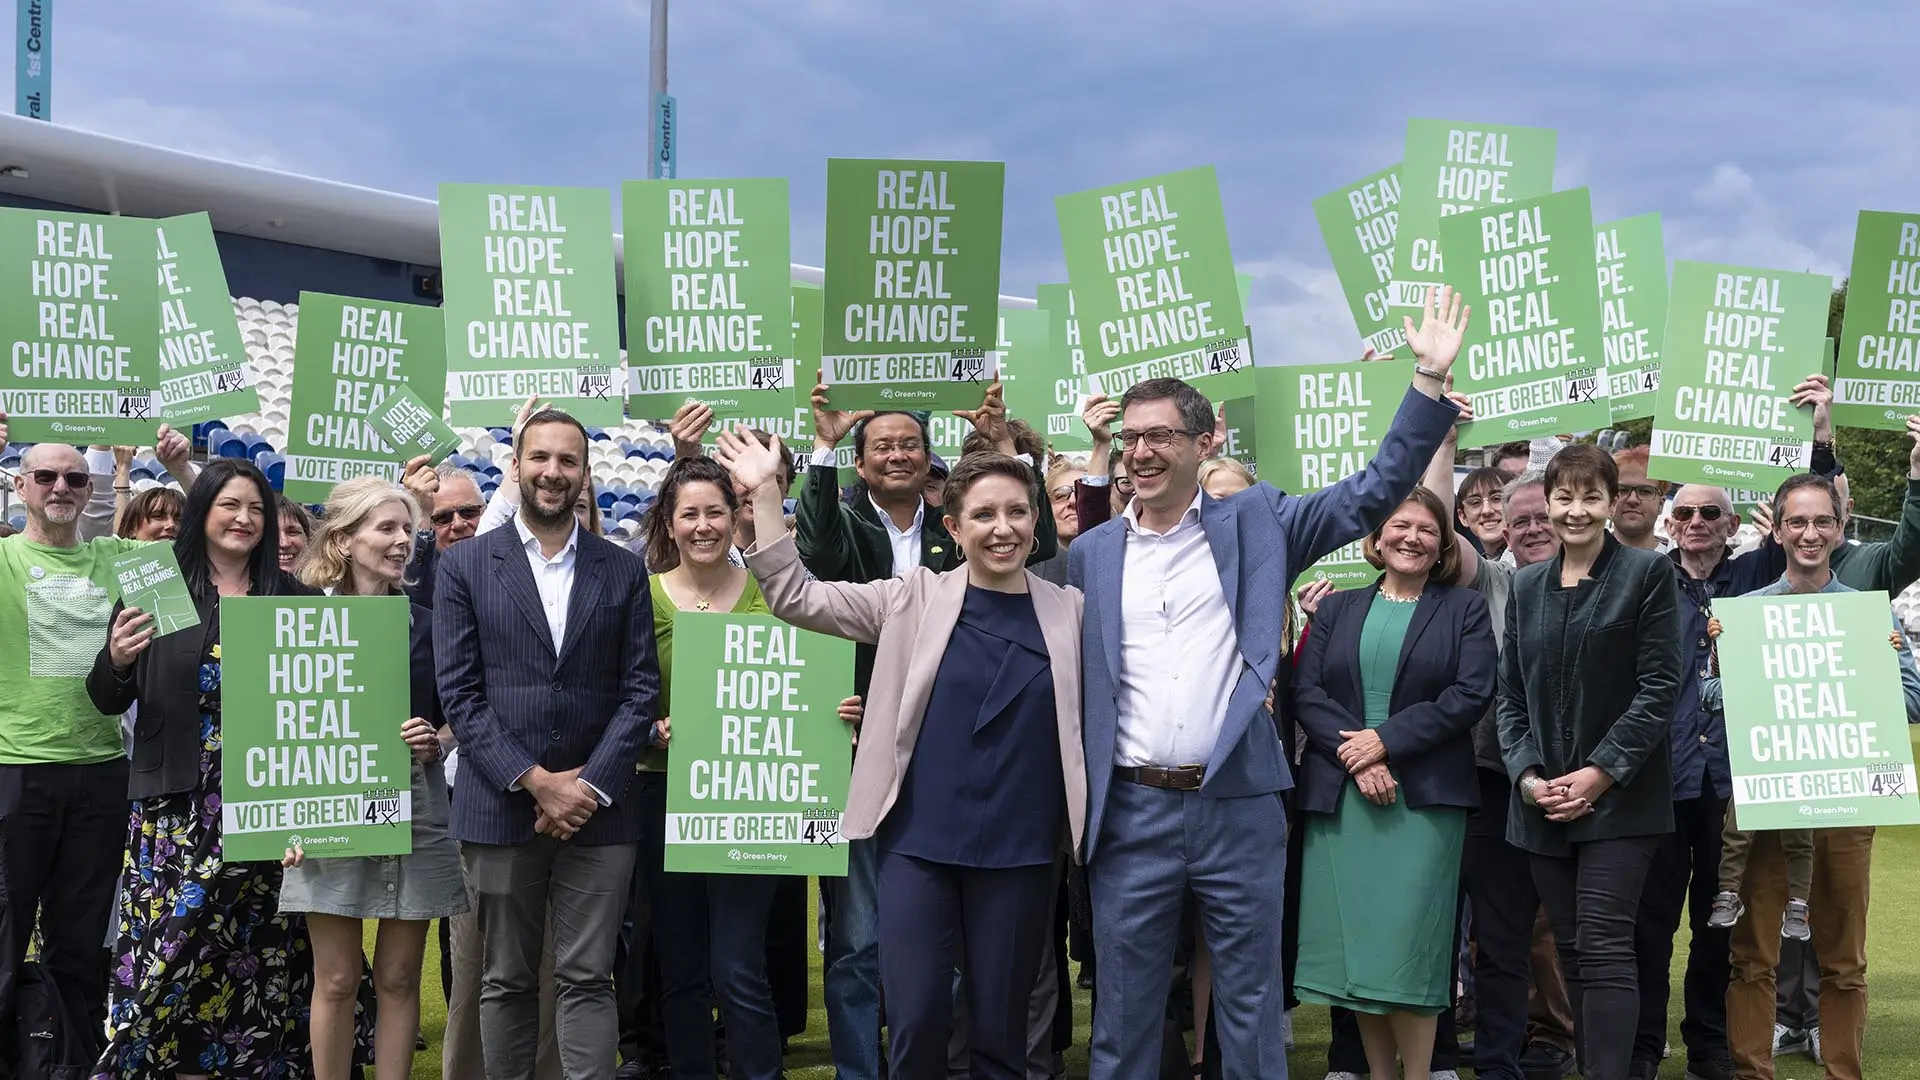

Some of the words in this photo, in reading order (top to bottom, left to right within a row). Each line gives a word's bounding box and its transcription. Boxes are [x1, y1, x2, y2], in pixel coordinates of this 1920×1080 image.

[1446, 130, 1513, 166] REAL
[877, 170, 955, 210] REAL
[1437, 166, 1514, 204] HOPE.
[488, 194, 566, 232] REAL
[668, 188, 744, 226] REAL
[1101, 185, 1178, 232] REAL
[37, 220, 112, 260] REAL
[869, 216, 958, 255] HOPE.
[1354, 210, 1399, 254] HOP
[1481, 206, 1551, 253] REAL
[1596, 229, 1627, 263] AL
[484, 236, 574, 274] HOPE.
[664, 231, 748, 268] HOPE.
[1103, 224, 1190, 273] HOPE.
[32, 260, 118, 300] HOPE.
[874, 260, 951, 299] REAL
[1117, 266, 1192, 312] REAL
[1480, 247, 1559, 296] HOPE.
[1598, 262, 1634, 298] PE.
[494, 279, 572, 316] REAL
[671, 274, 746, 310] REAL
[1714, 272, 1784, 314] REAL
[39, 301, 114, 341] REAL
[160, 298, 197, 334] AL
[340, 306, 408, 344] REAL
[844, 304, 975, 342] CHANGE.
[1100, 302, 1224, 358] CHANGE.
[1488, 290, 1558, 336] REAL
[1603, 298, 1634, 332] AL
[1704, 310, 1784, 352] HOPE.
[468, 320, 600, 360] CHANGE.
[646, 315, 772, 352] CHANGE.
[1604, 328, 1658, 367] NGE.
[12, 341, 140, 382] CHANGE.
[332, 342, 409, 382] HOPE.
[833, 357, 880, 382] VOTE
[886, 354, 946, 380] GREEN
[952, 359, 963, 380] 4
[963, 359, 983, 370] JULY
[1148, 352, 1206, 379] GREEN
[1210, 353, 1222, 372] 4
[1220, 348, 1237, 362] JULY
[1468, 328, 1585, 382] CHANGE.
[1705, 350, 1776, 391] REAL
[160, 374, 212, 402] GREEN
[217, 375, 228, 392] 4
[226, 370, 241, 382] JULY
[460, 374, 507, 397] VOTE
[514, 372, 573, 396] GREEN
[580, 376, 591, 396] 4
[591, 376, 610, 387] JULY
[638, 366, 682, 392] VOTE
[689, 364, 746, 388] GREEN
[752, 367, 763, 388] 4
[763, 366, 781, 378] JULY
[894, 390, 916, 398] Green
[918, 390, 936, 400] Party
[1300, 372, 1371, 408] REAL
[1509, 380, 1563, 410] GREEN
[1568, 381, 1579, 401] 4
[1578, 378, 1597, 392] JULY
[1610, 372, 1640, 396] EEN
[1644, 374, 1654, 390] 4
[1844, 380, 1887, 404] VOTE
[1891, 384, 1920, 404] GRE
[3, 391, 49, 414] VOTE
[55, 392, 113, 414] GREEN
[120, 397, 130, 417] 4
[130, 398, 148, 408] JULY
[382, 396, 417, 428] VOTE
[1674, 386, 1794, 432] CHANGE.
[65, 424, 85, 432] Green
[86, 424, 106, 433] Party
[392, 406, 432, 445] GREEN
[1295, 412, 1376, 449] HOPE.
[1520, 418, 1540, 427] Green
[1540, 416, 1558, 424] Party
[795, 454, 804, 472] 4
[1662, 432, 1706, 456] VOTE
[1710, 436, 1766, 460] GREEN
[1770, 446, 1780, 466] 4
[1780, 446, 1800, 458] JULY
[296, 458, 336, 480] VOTE
[1715, 468, 1736, 476] Green
[1736, 470, 1754, 480] Party
[118, 568, 140, 584] REAL
[140, 560, 164, 576] HOPE.
[122, 580, 144, 596] REAL
[144, 566, 178, 586] CHANGE.
[276, 608, 358, 648] REAL
[1763, 603, 1846, 640] REAL
[724, 624, 805, 666] REAL
[1762, 642, 1856, 680] HOPE.
[269, 654, 364, 694] HOPE.
[716, 669, 808, 712] HOPE.
[1773, 682, 1856, 720] REAL
[276, 700, 360, 740] REAL
[721, 715, 802, 757] REAL
[1750, 722, 1890, 762] CHANGE.
[246, 744, 388, 787] CHANGE.
[690, 760, 828, 803] CHANGE.
[1871, 774, 1883, 795] 4
[1882, 772, 1902, 784] JULY
[1744, 775, 1794, 800] VOTE
[1800, 771, 1864, 797] GREEN
[235, 802, 287, 830] VOTE
[294, 798, 358, 826] GREEN
[366, 801, 378, 823] 4
[377, 800, 398, 812] JULY
[677, 816, 728, 840] VOTE
[734, 816, 798, 840] GREEN
[1838, 806, 1858, 814] Party
[304, 836, 328, 844] Green
[328, 836, 349, 845] Party
[804, 820, 816, 843] 4
[816, 820, 836, 833] JULY
[743, 852, 766, 860] Green
[766, 852, 788, 862] Party
